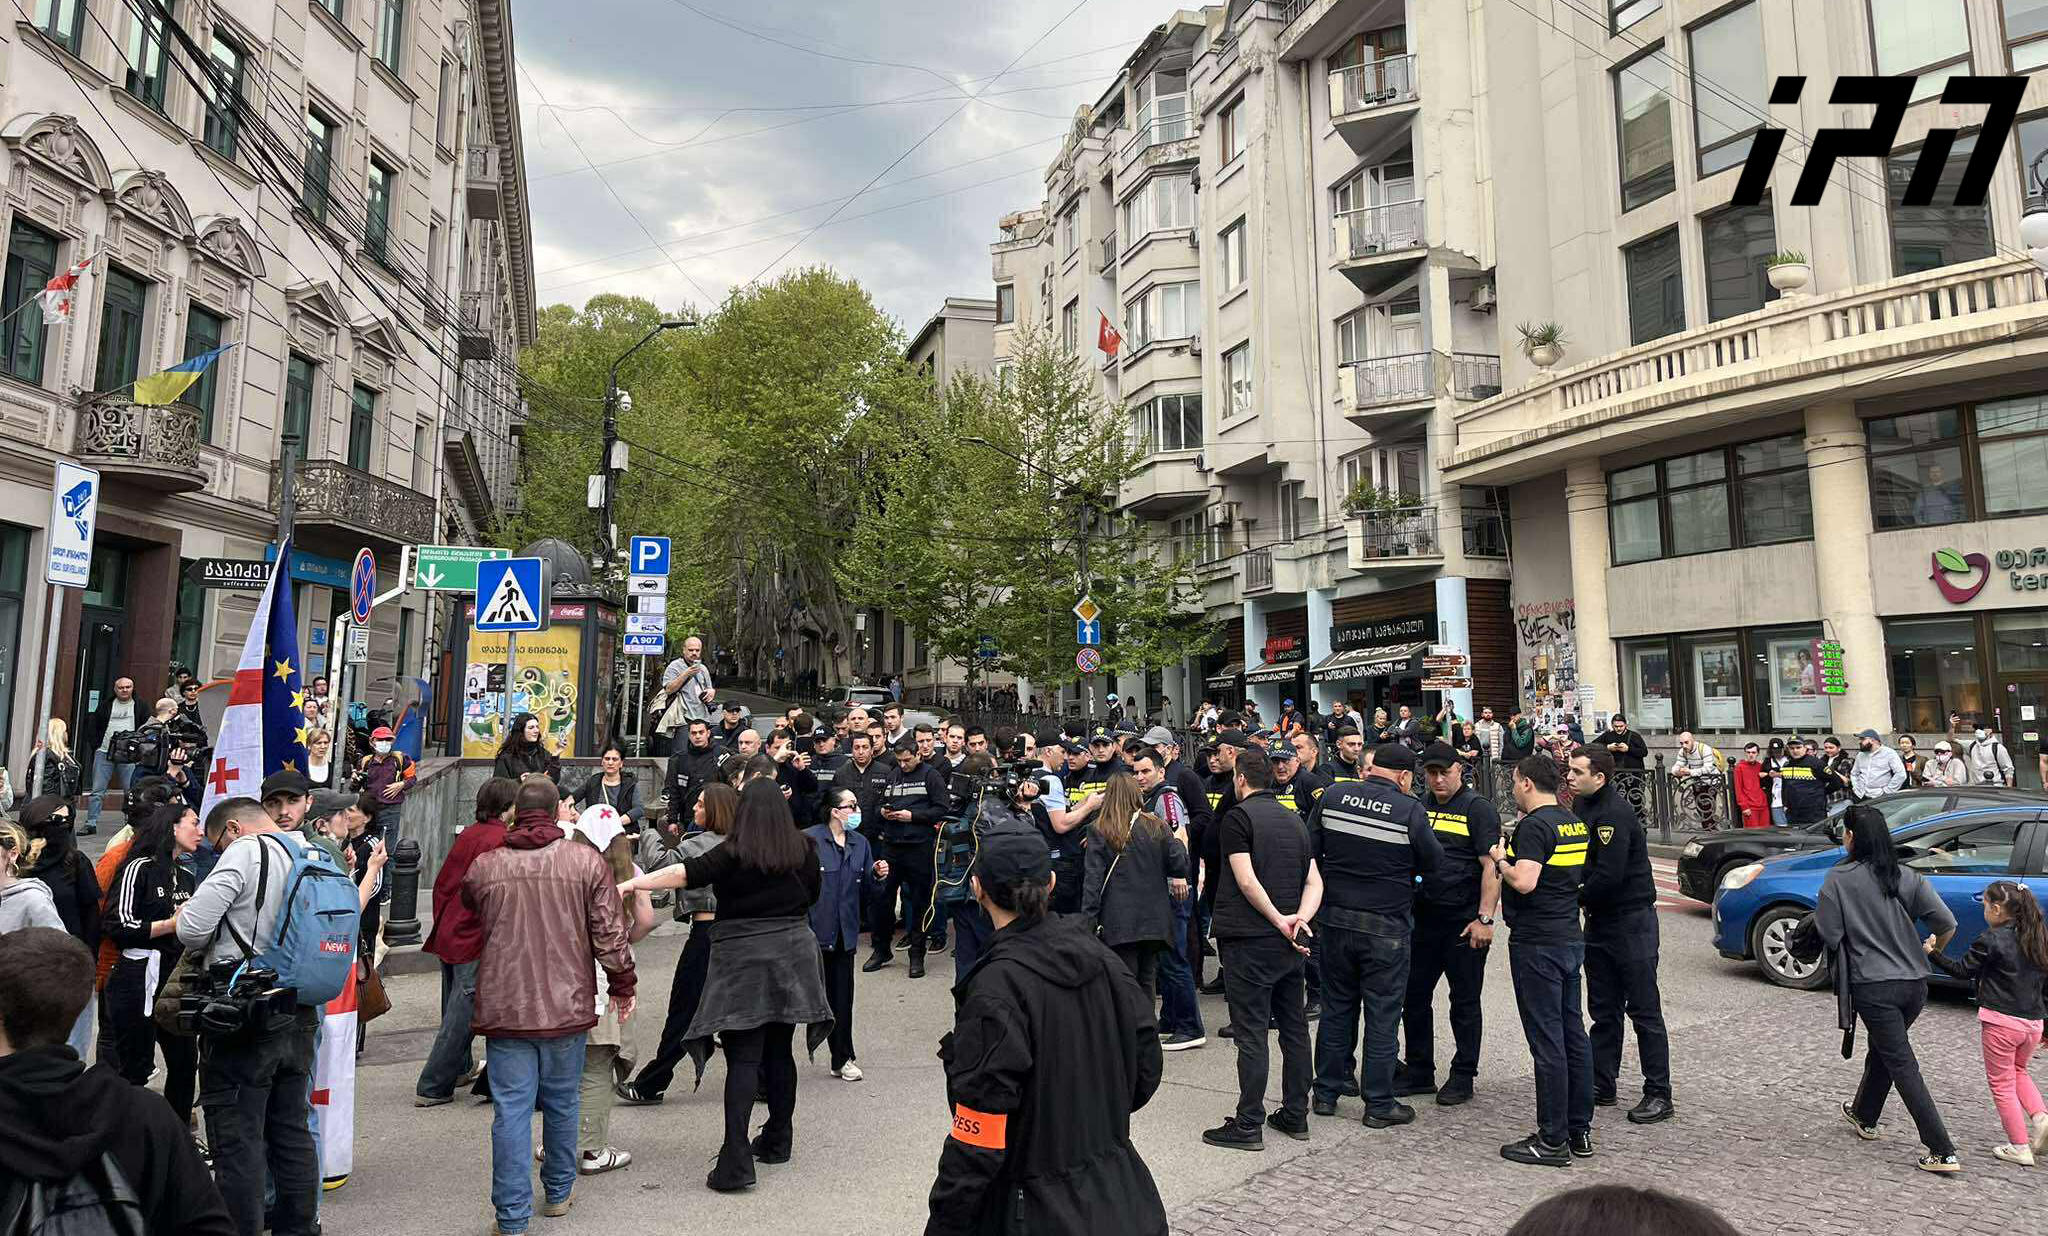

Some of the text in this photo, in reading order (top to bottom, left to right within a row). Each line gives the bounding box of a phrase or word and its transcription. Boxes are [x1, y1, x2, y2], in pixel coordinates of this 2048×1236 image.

[639, 541, 661, 570] P
[640, 636, 657, 644] 907
[1341, 794, 1393, 815] POLICE
[1557, 822, 1587, 836] POLICE
[953, 1114, 981, 1135] RESS
